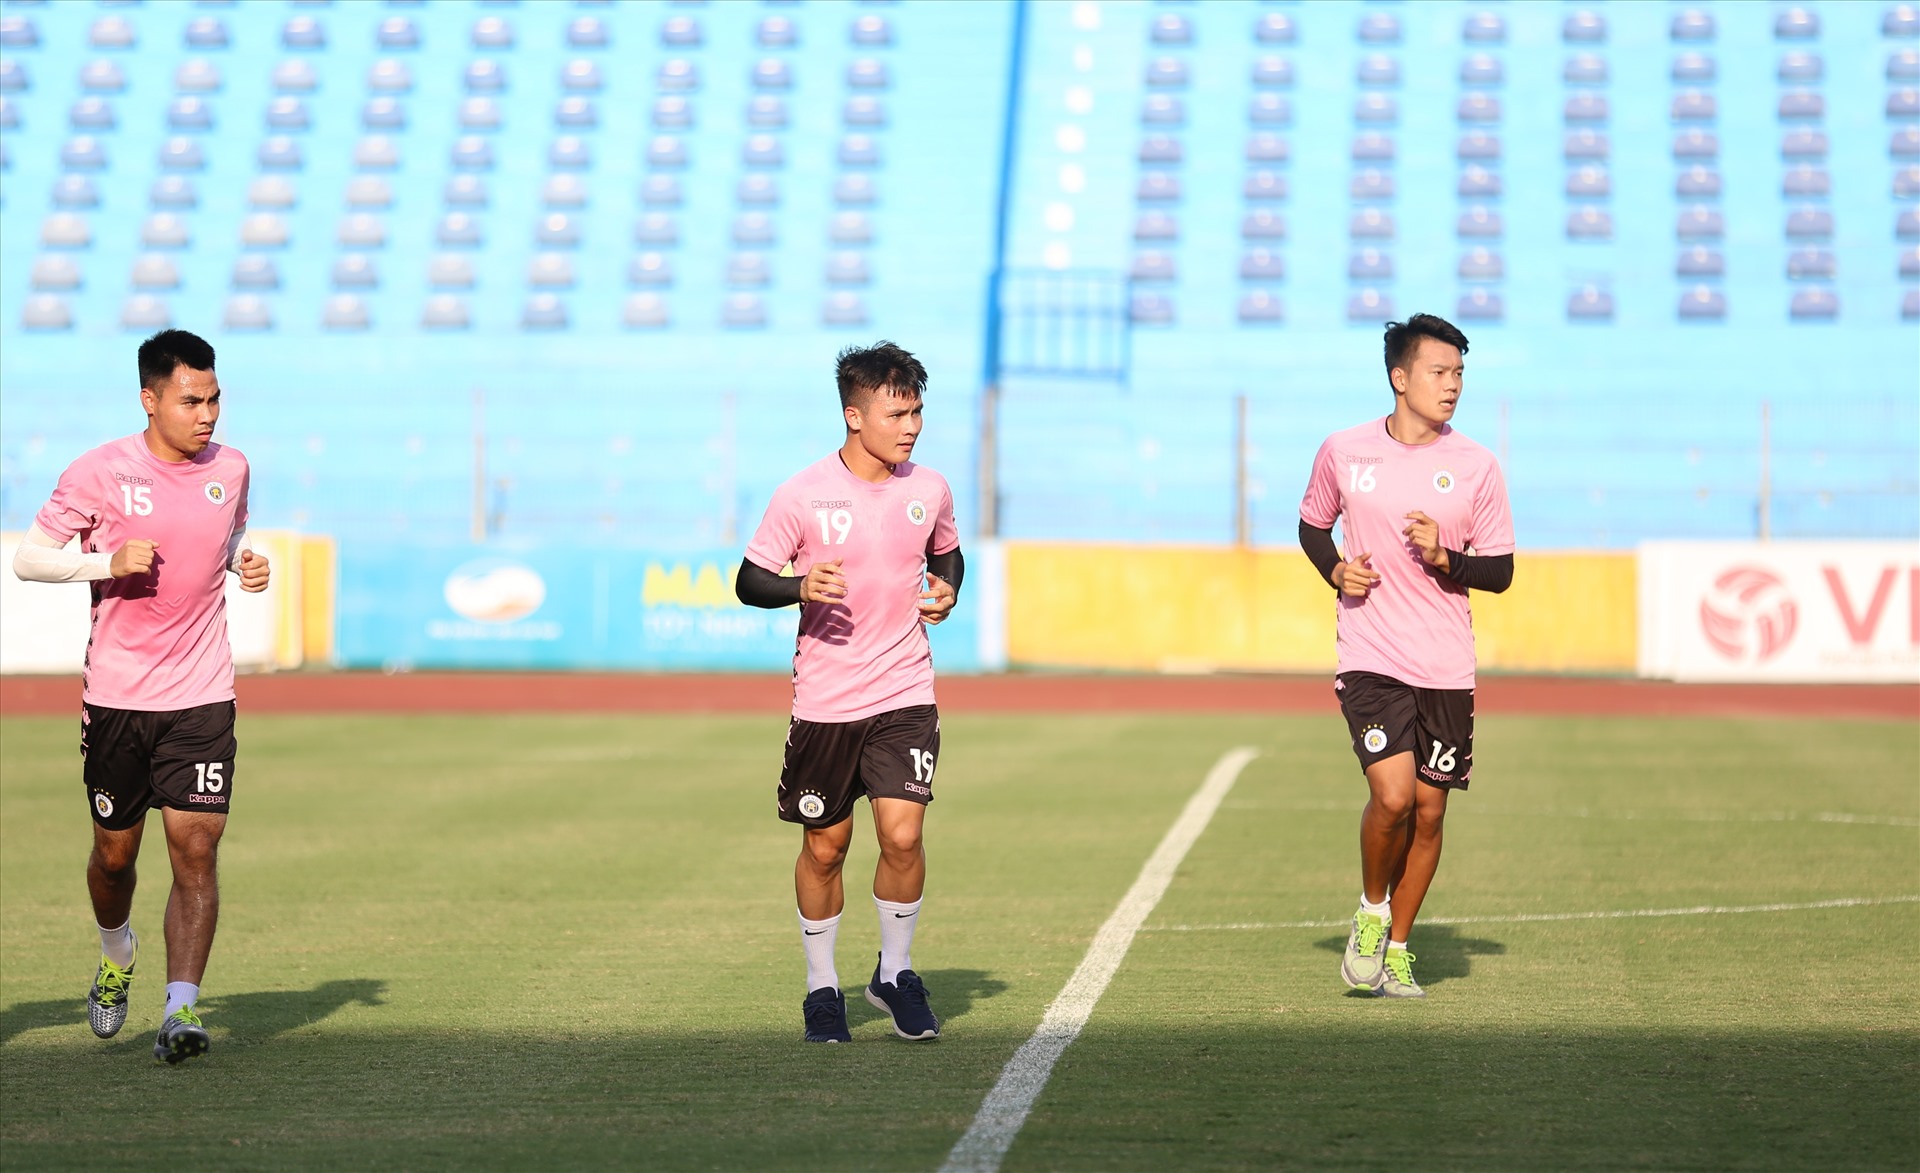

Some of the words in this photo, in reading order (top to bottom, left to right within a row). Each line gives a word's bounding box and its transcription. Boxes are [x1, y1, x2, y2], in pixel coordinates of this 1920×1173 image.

[1346, 455, 1384, 465] Kappa
[115, 472, 154, 486] Kappa
[1349, 464, 1376, 493] 16
[120, 484, 154, 516] 15
[811, 499, 852, 509] Kappa
[815, 509, 853, 545] 19
[909, 748, 934, 784] 19
[1428, 739, 1457, 773] 16
[195, 762, 224, 793] 15
[904, 781, 931, 796] Kapp
[189, 794, 226, 804] Kappa
